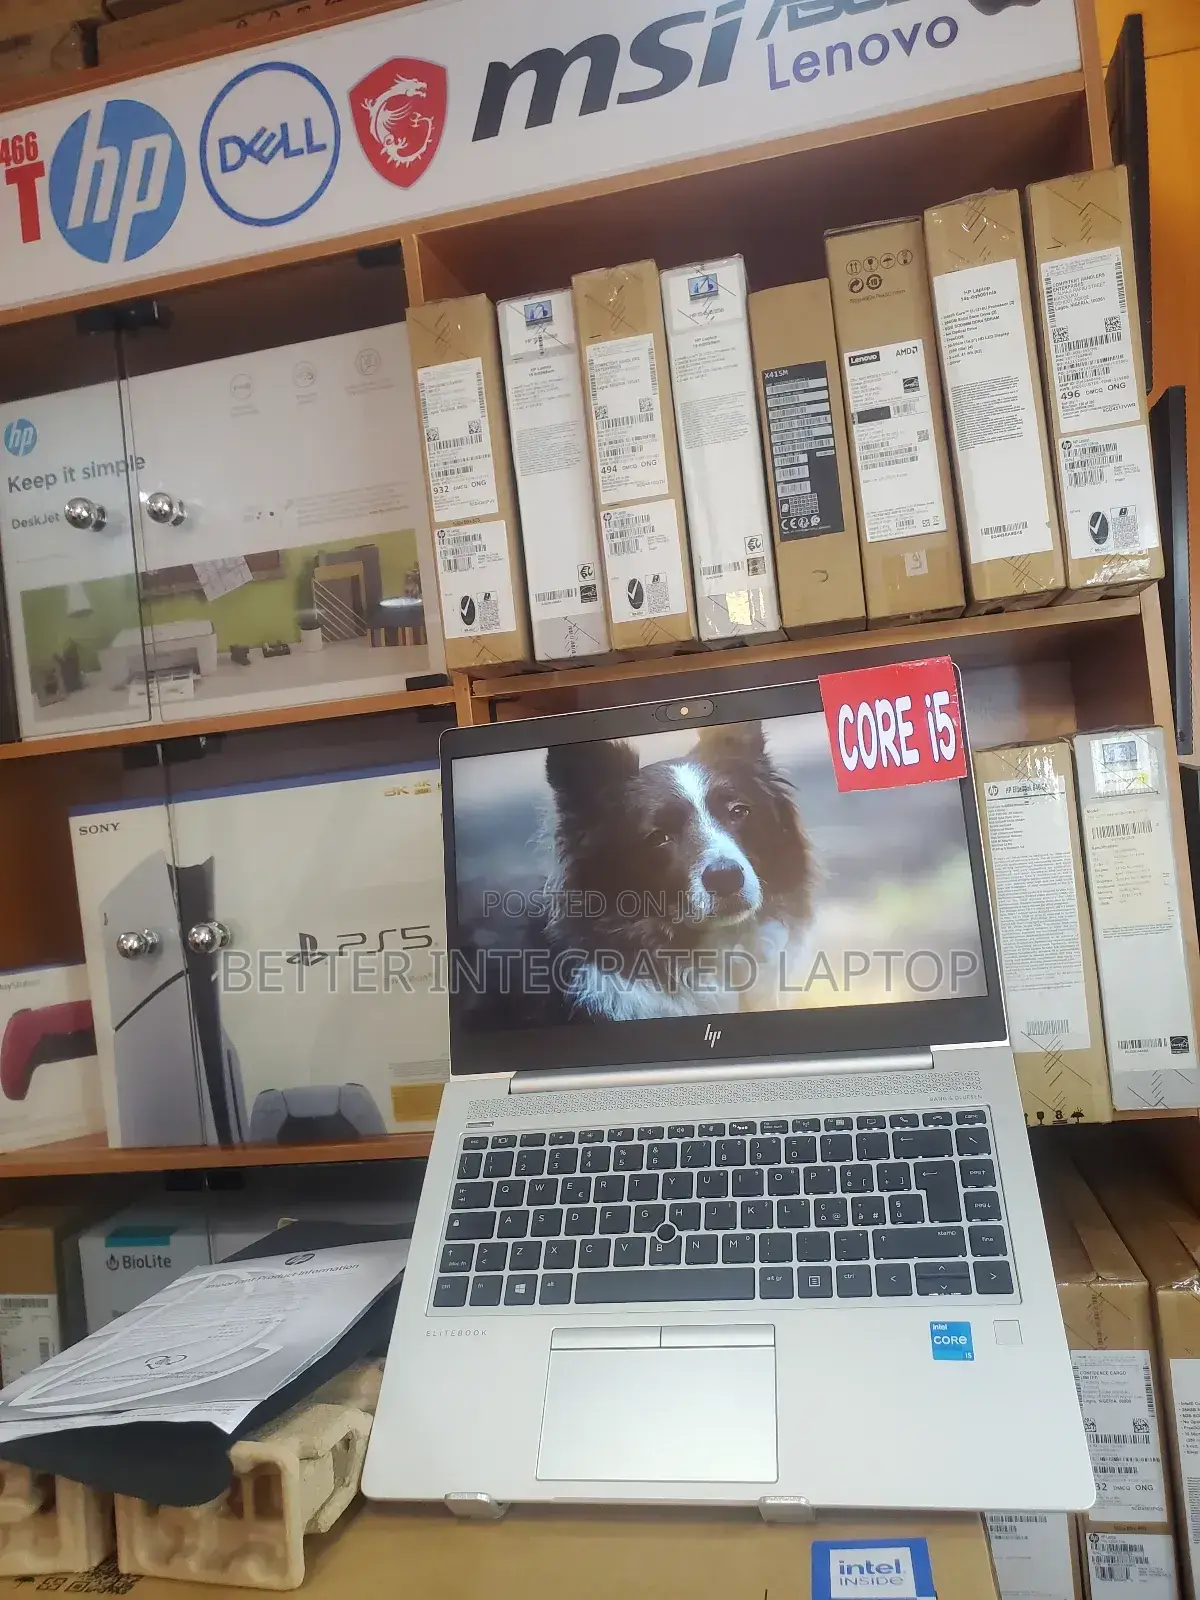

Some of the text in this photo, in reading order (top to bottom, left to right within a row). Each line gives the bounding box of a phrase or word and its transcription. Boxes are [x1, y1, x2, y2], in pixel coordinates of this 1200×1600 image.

[767, 15, 959, 91] Lenovo
[472, 0, 745, 141] msi
[219, 117, 327, 174] DELL
[67, 101, 173, 262] hp
[5, 160, 45, 243] T
[850, 354, 878, 364] Lenovo
[896, 348, 912, 357] AMD
[1060, 390, 1080, 400] 496
[1107, 382, 1126, 391] ONG
[6, 418, 37, 456] hp
[8, 454, 146, 494] Keep it simple
[601, 465, 618, 474] 494
[640, 459, 657, 468] ONG
[433, 485, 450, 494] 932
[471, 479, 487, 488] ONG
[11, 513, 60, 530] DeskJet
[838, 690, 956, 772] CORE i5
[79, 822, 121, 837] SONY
[336, 926, 433, 957] PS5
[641, 1209, 649, 1218] G
[711, 1207, 717, 1215] J
[516, 1247, 524, 1255] Z
[585, 1244, 593, 1253] C
[621, 1243, 629, 1252] V
[656, 1243, 663, 1252] B
[692, 1240, 700, 1249] N
[729, 1240, 738, 1248] M
[122, 1254, 172, 1269] BioLite
[298, 1264, 360, 1276] Information
[1096, 1483, 1108, 1491] 32
